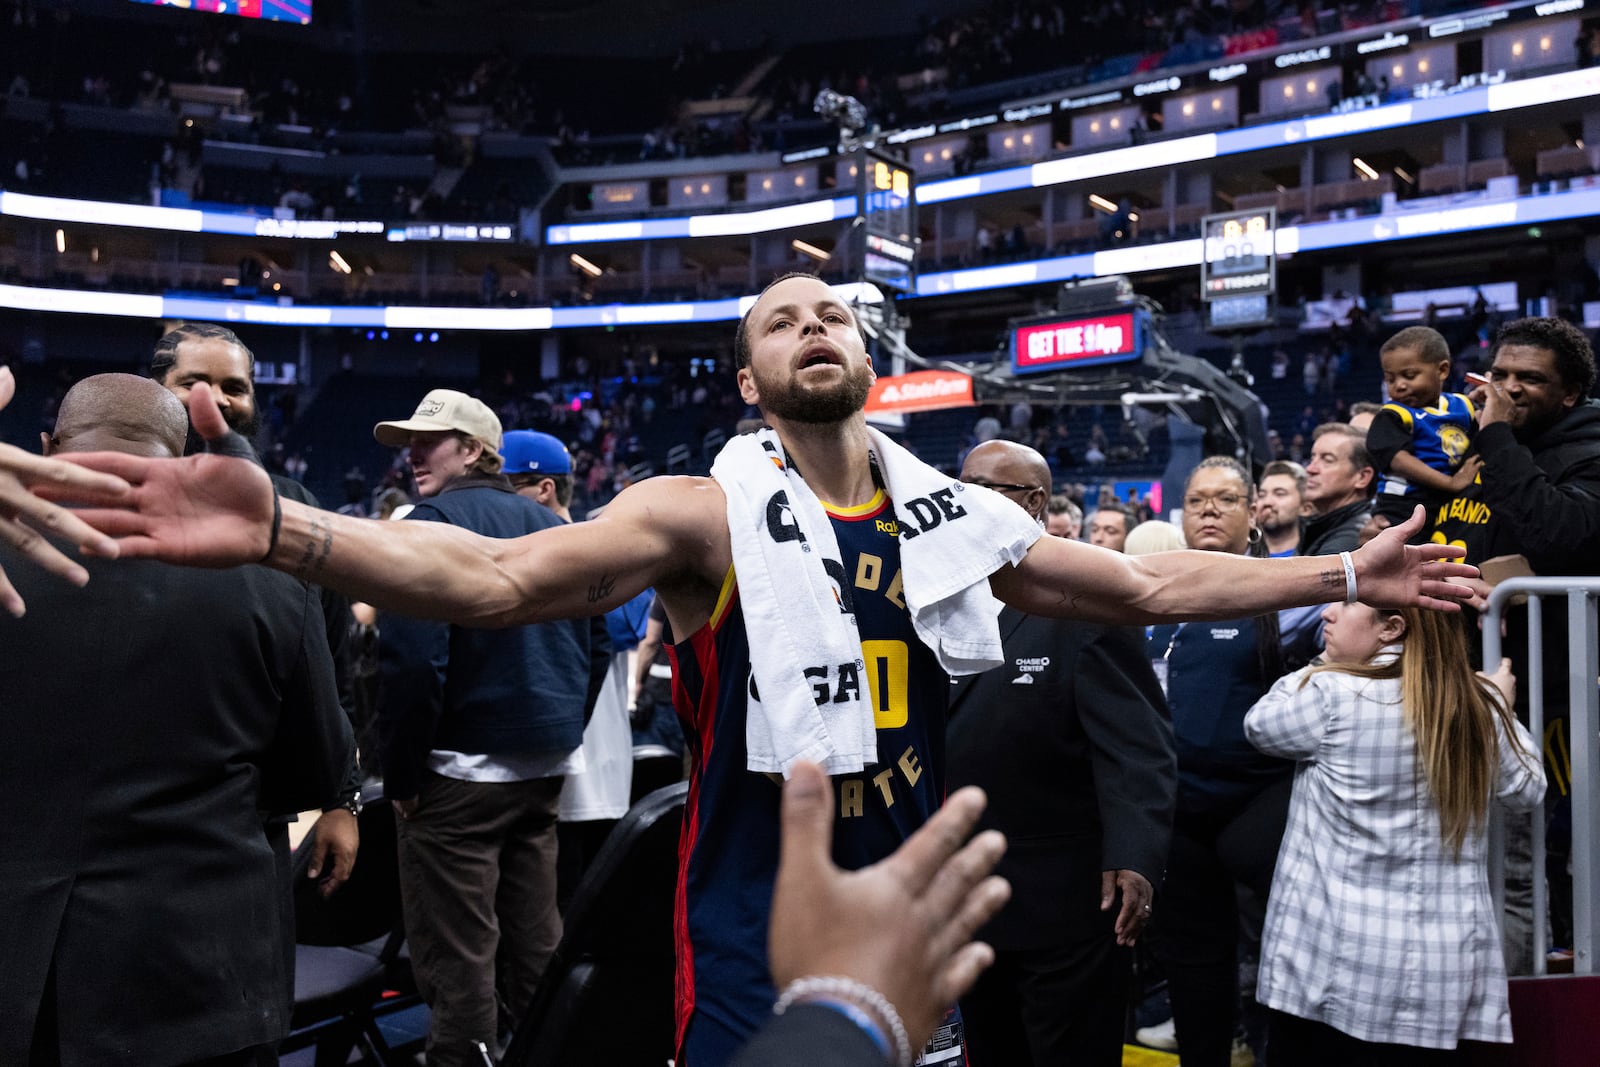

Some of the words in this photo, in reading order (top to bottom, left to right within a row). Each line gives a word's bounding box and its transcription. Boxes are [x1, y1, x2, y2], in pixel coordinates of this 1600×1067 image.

[1028, 330, 1054, 359] GET
[1055, 326, 1084, 355] THE
[1015, 658, 1041, 666] CHASE
